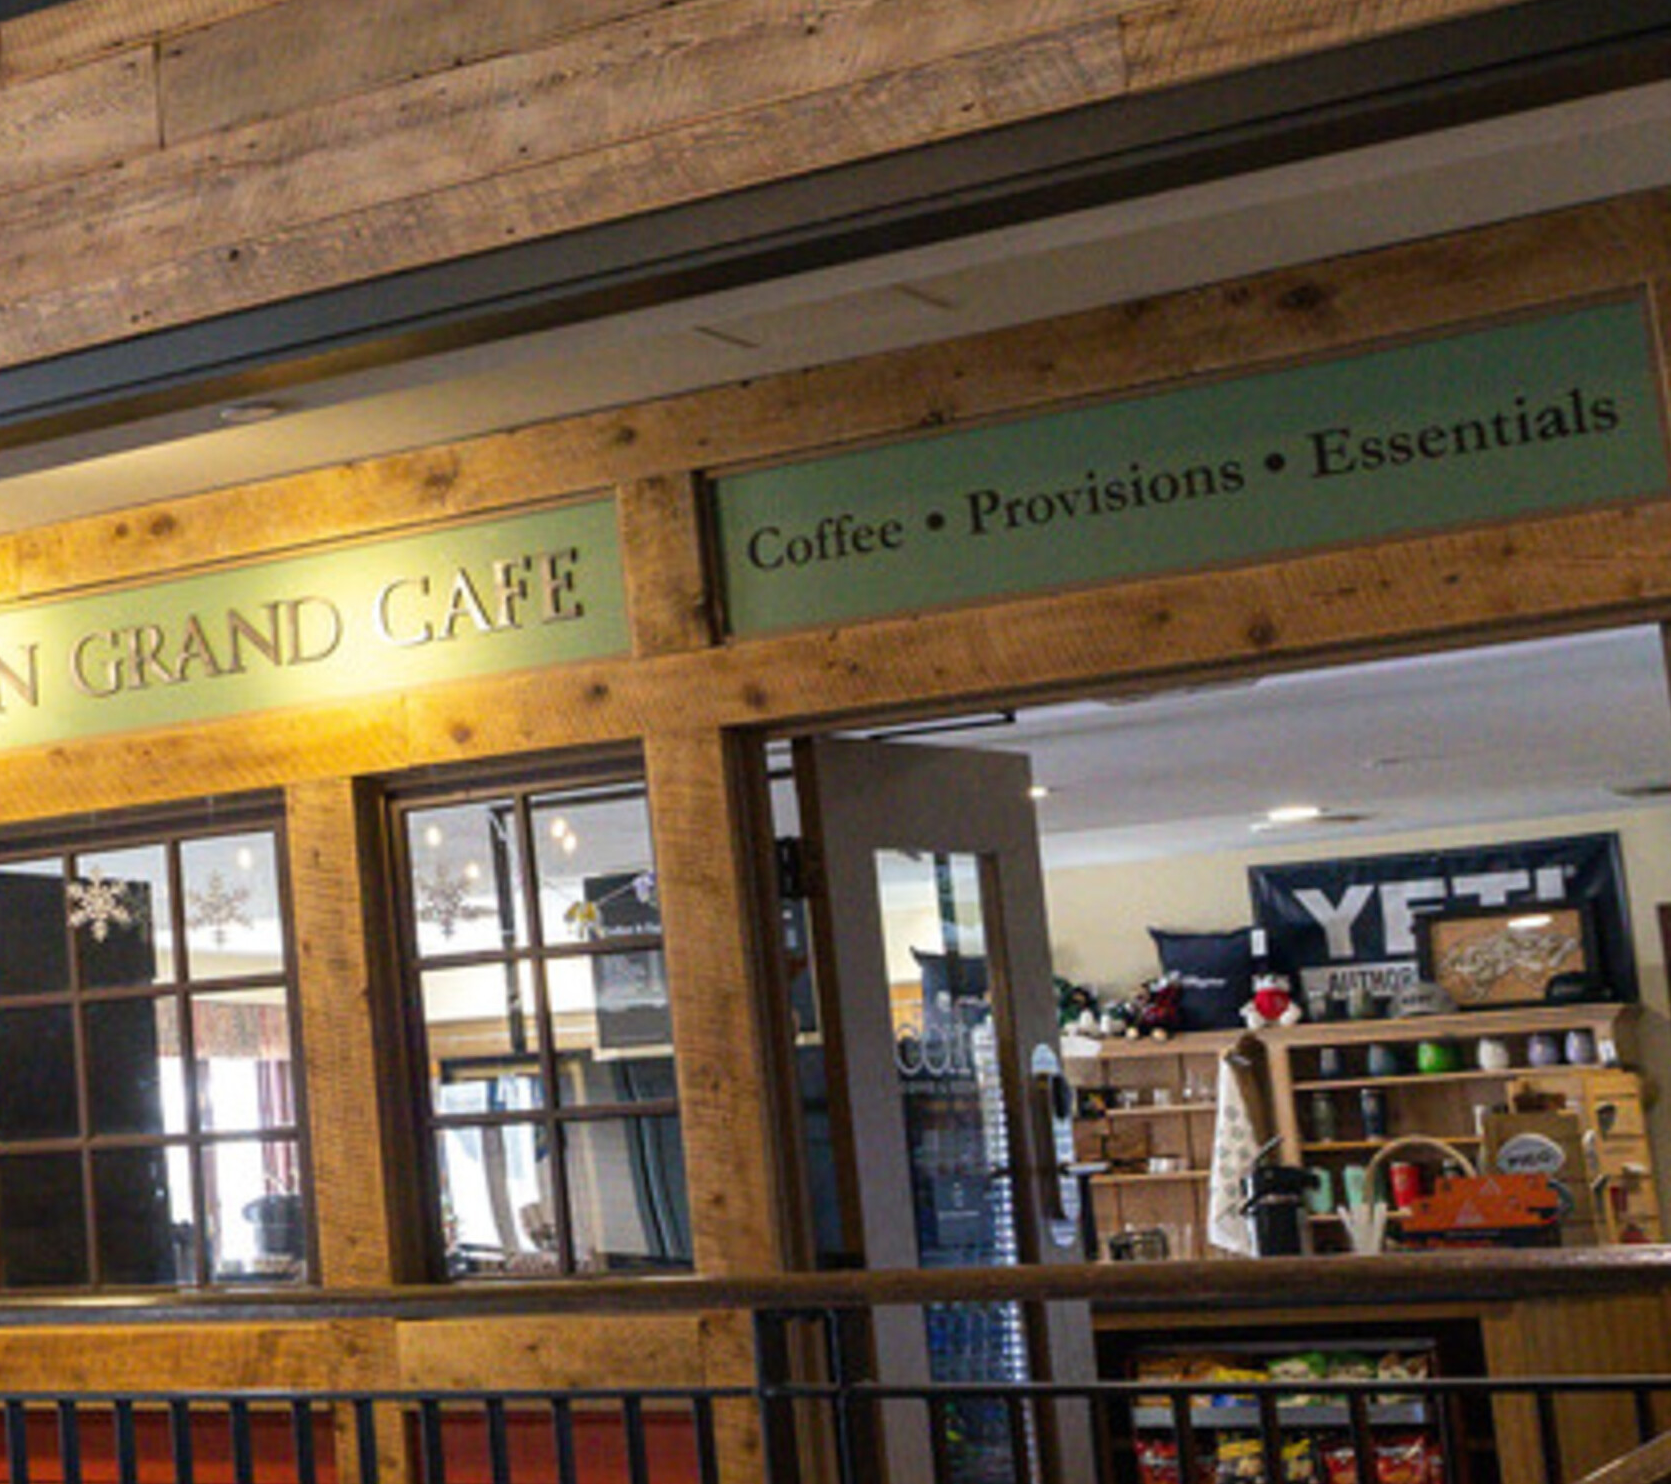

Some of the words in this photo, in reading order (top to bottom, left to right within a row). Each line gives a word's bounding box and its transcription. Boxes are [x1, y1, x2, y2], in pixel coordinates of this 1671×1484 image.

[746, 514, 904, 571] Coffee
[966, 458, 1245, 536] Provisions
[1308, 388, 1621, 480] Essentials
[68, 595, 343, 699] GRAND
[373, 547, 585, 649] CAFE
